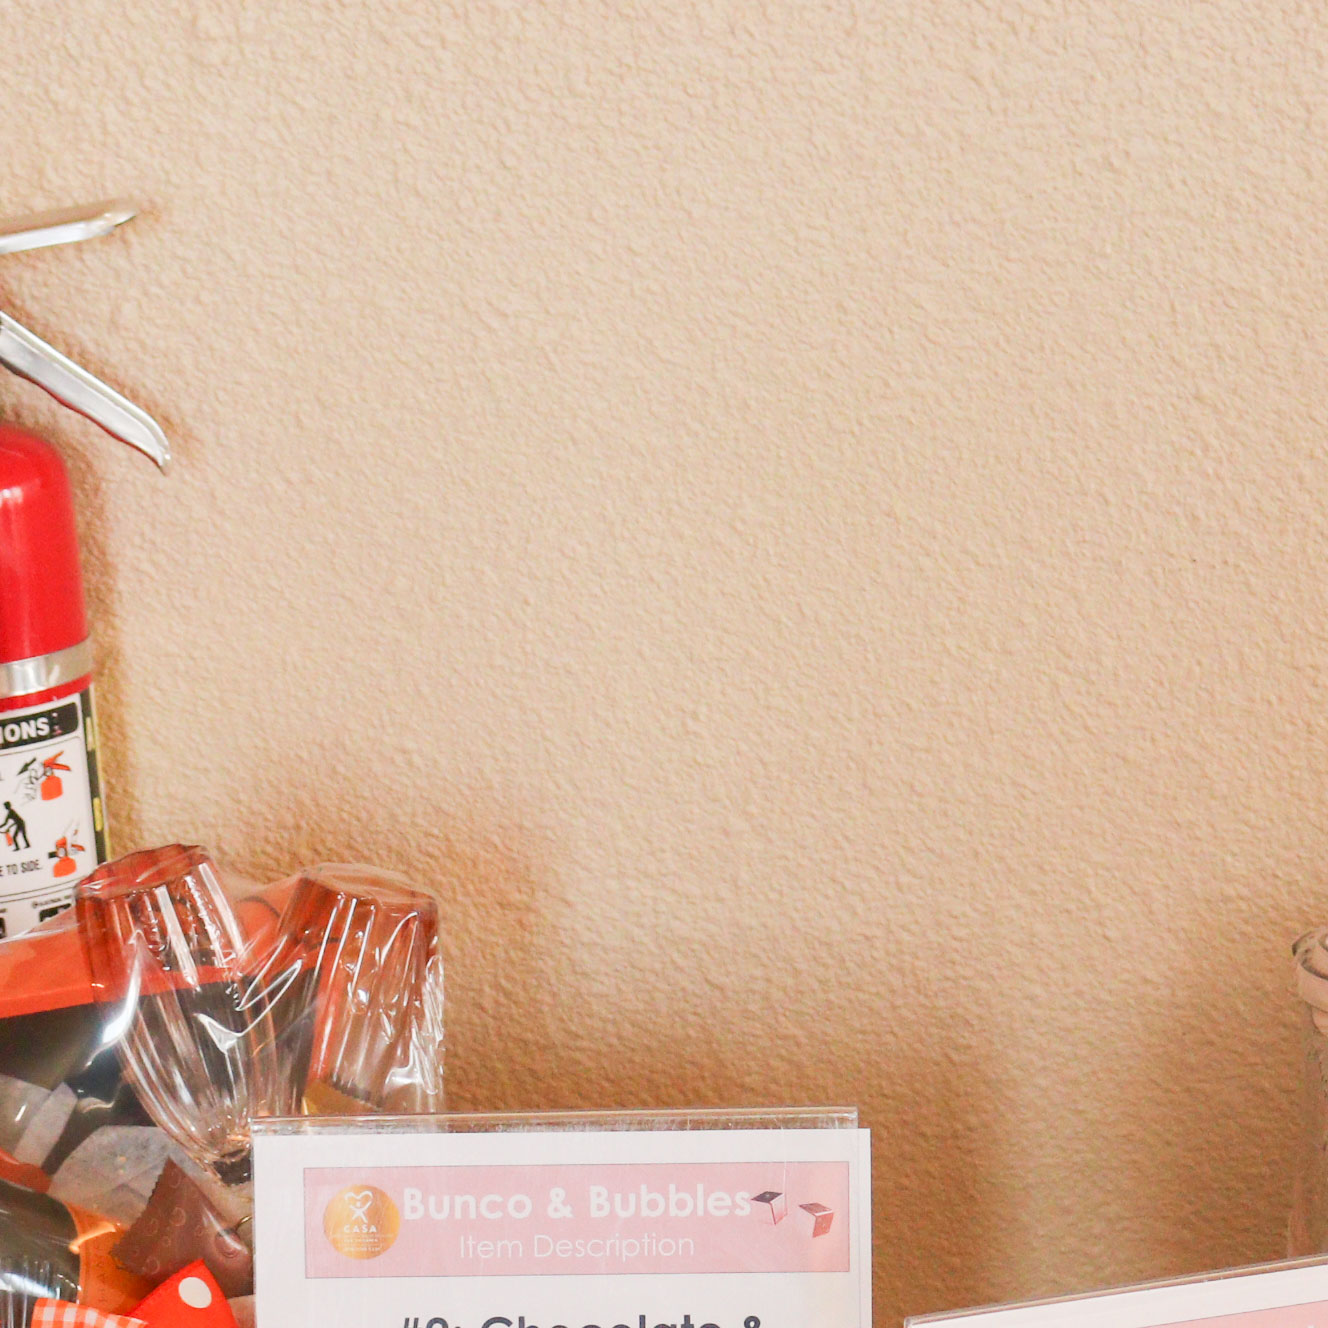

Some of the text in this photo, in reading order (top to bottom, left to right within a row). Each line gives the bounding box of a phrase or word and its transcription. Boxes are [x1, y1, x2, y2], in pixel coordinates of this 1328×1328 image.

[4, 864, 17, 875] TO
[21, 860, 42, 873] SIDE.
[403, 1184, 751, 1221] Bunco & Bubbles
[344, 1224, 377, 1233] CASA
[459, 1234, 694, 1262] Item Description
